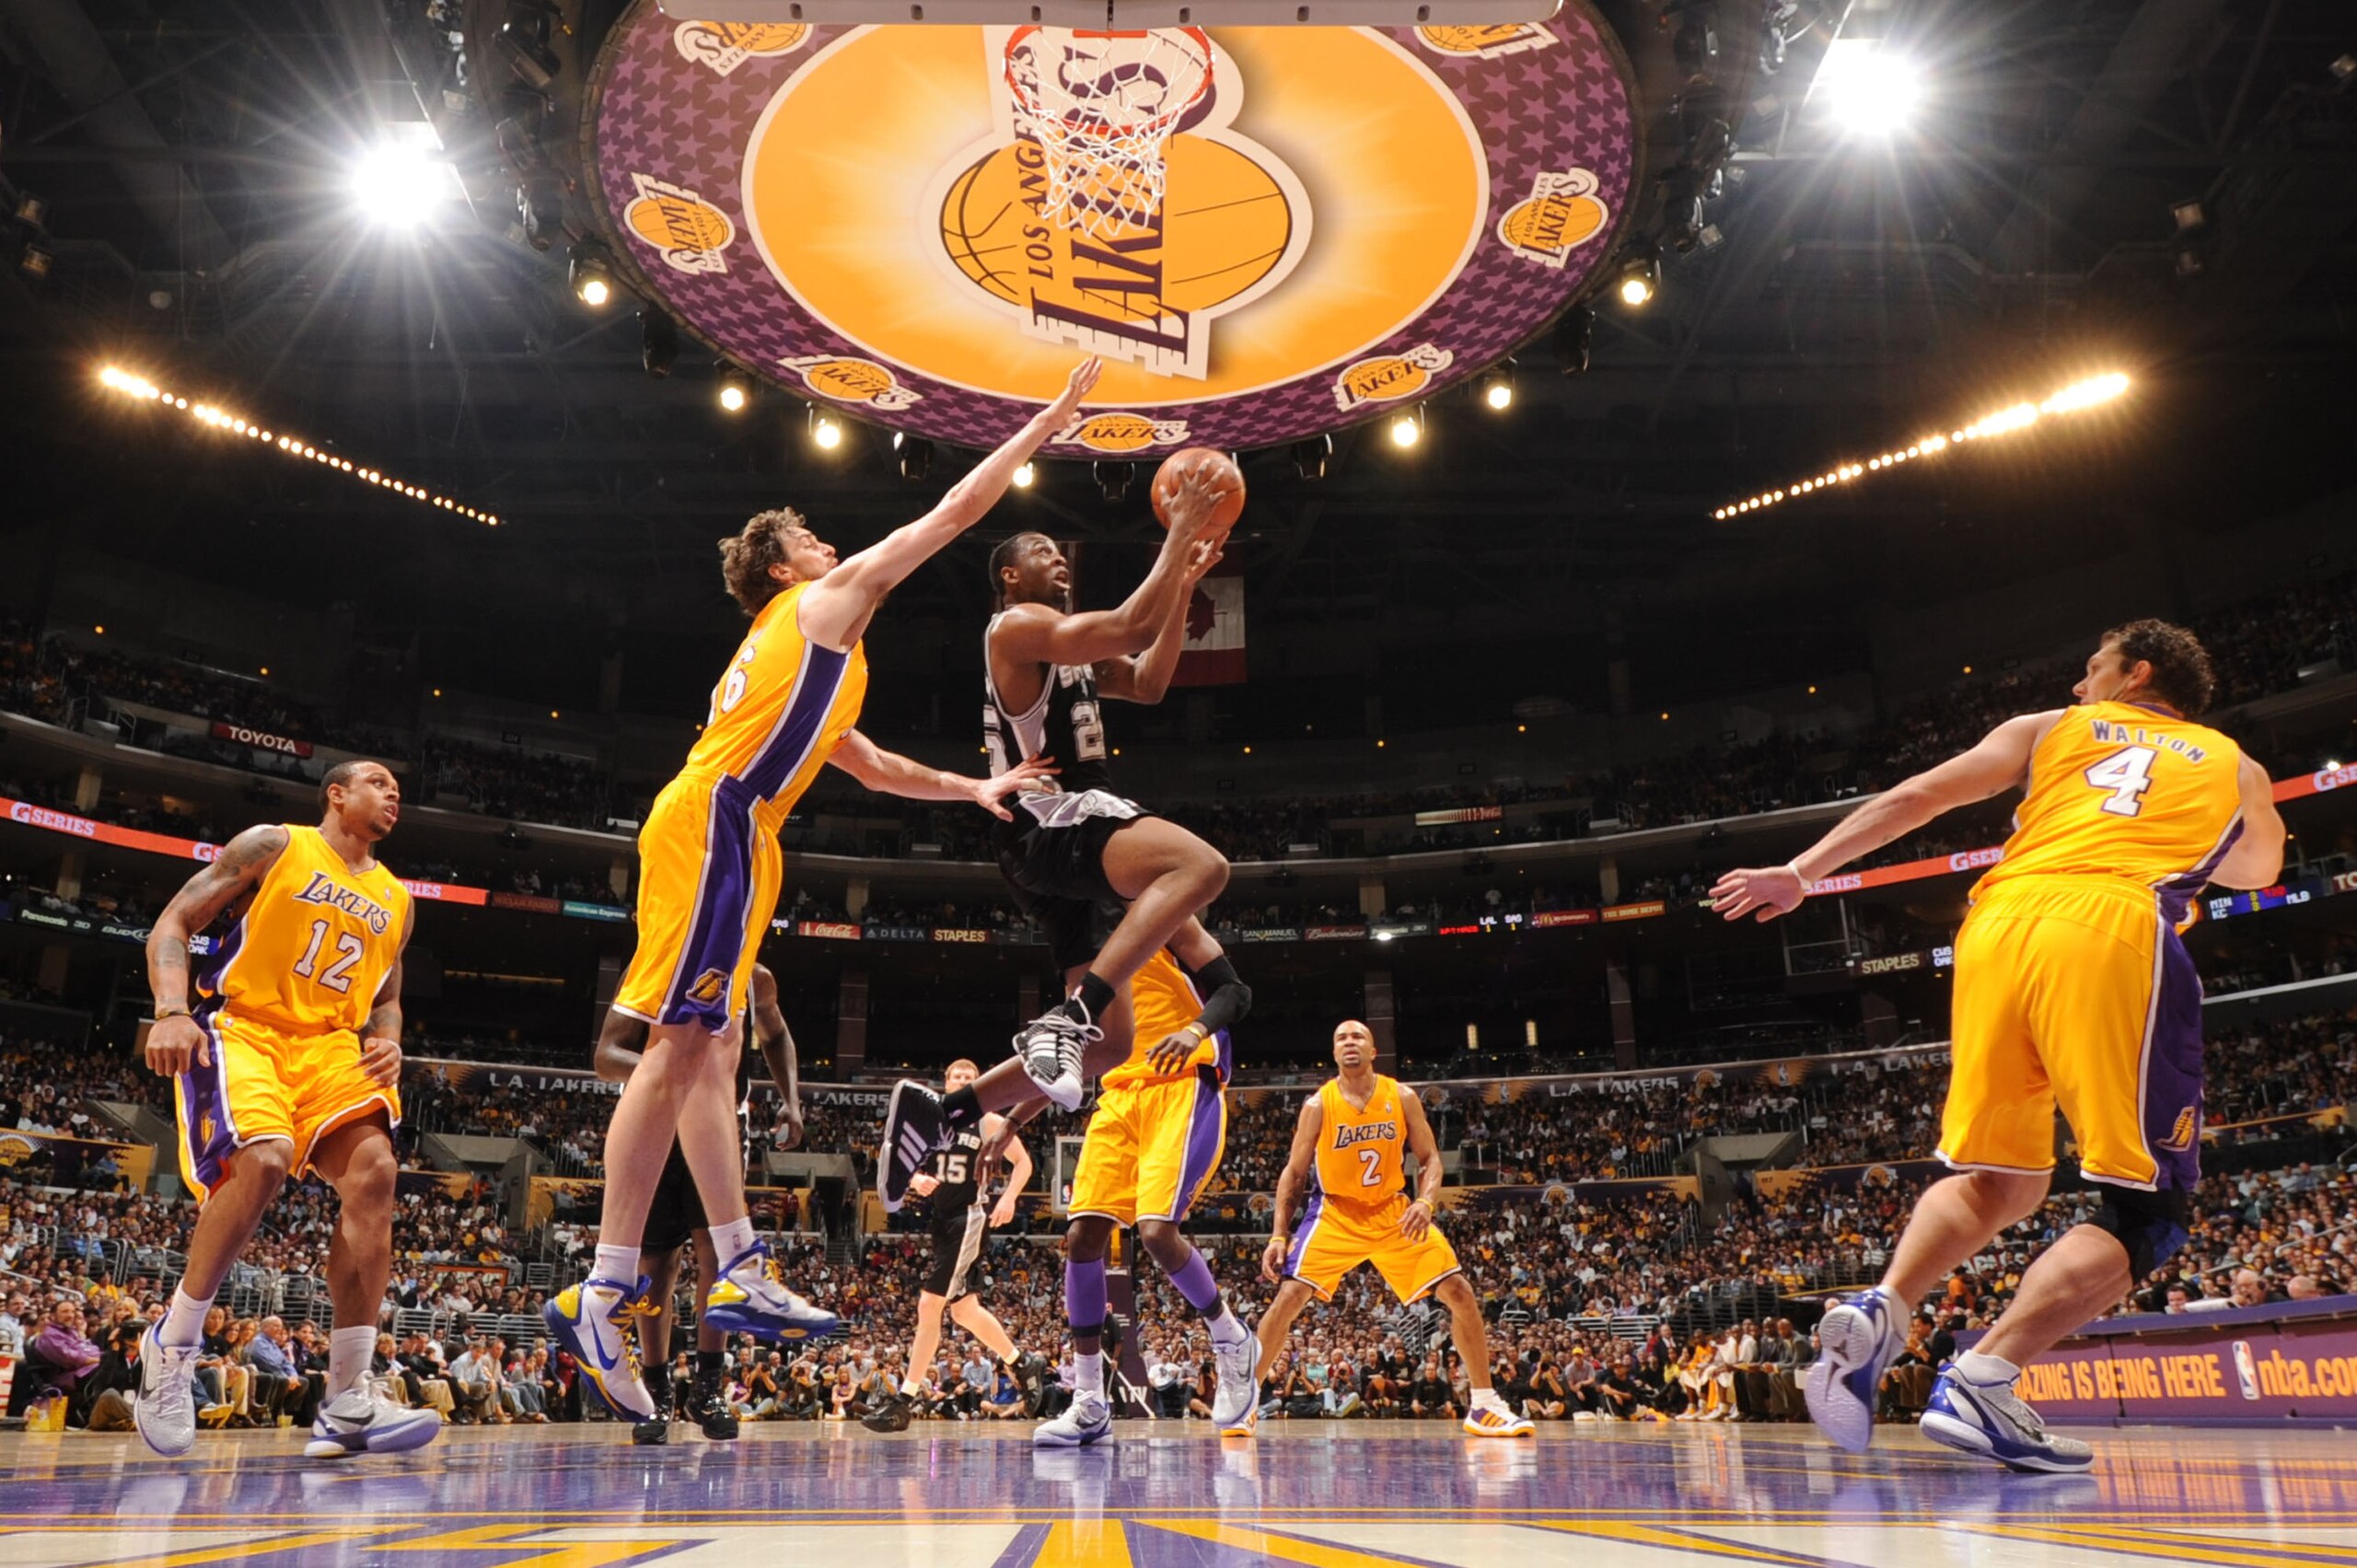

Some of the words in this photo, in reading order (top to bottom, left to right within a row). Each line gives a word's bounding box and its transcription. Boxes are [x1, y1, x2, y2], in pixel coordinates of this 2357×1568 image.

[643, 180, 708, 270] LAKERS
[1519, 175, 1591, 261] LAKERS
[1023, 224, 1054, 280] LOS
[795, 360, 901, 405] LAKERS
[1343, 351, 1448, 403] LAKERS
[1065, 424, 1176, 442] LAKERS
[228, 726, 297, 753] TOYOTA
[2089, 717, 2207, 765] WALTON
[2084, 744, 2159, 818] 4
[31, 805, 95, 836] SERIES
[292, 870, 393, 937] LAKERS
[563, 904, 598, 914] American
[598, 908, 627, 919] Express
[2210, 896, 2234, 910] MIN
[2212, 908, 2228, 920] KC
[21, 909, 68, 927] Panasonic
[73, 920, 91, 930] 3D
[880, 930, 924, 939] DELTA
[1265, 928, 1297, 937] MANUEL
[1307, 927, 1365, 939] Budweiser
[1480, 916, 1498, 925] LAL
[934, 929, 986, 942] STAPLES
[293, 918, 365, 994] 12
[1862, 954, 1921, 974] STAPLES
[1332, 1120, 1398, 1151] LAKERS
[935, 1153, 969, 1184] 15
[1358, 1147, 1382, 1188] 2
[2072, 1361, 2096, 1400] IS
[2093, 1356, 2163, 1400] BEING
[2161, 1353, 2227, 1398] HERE
